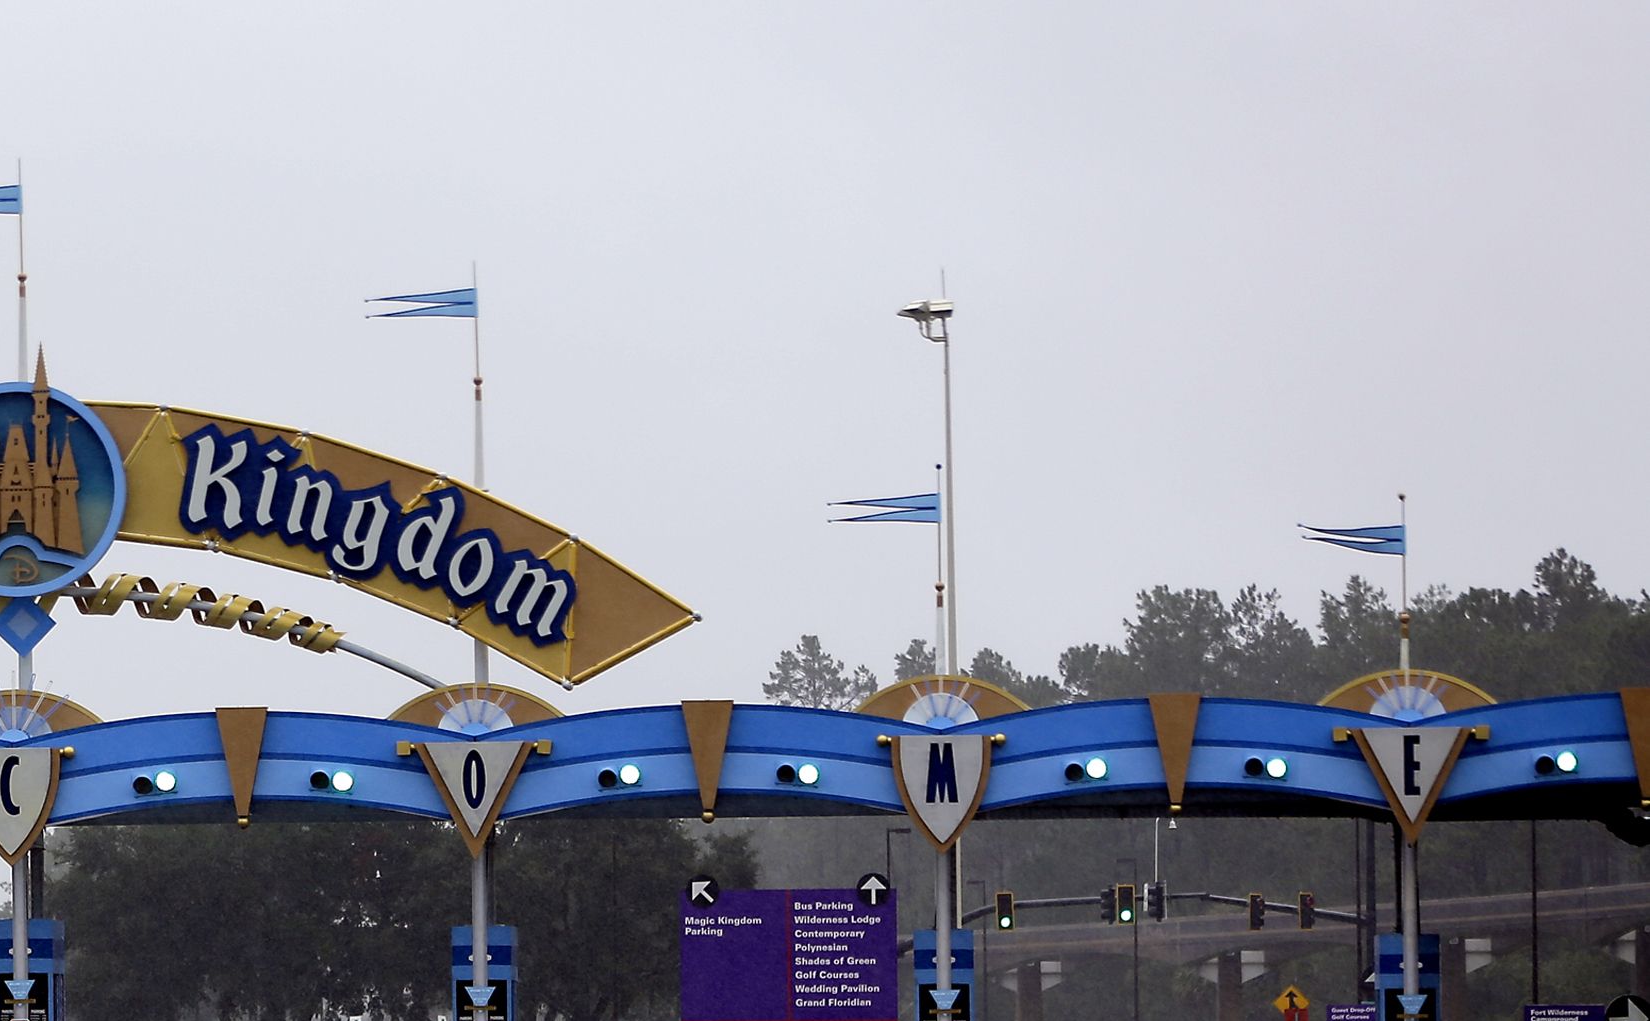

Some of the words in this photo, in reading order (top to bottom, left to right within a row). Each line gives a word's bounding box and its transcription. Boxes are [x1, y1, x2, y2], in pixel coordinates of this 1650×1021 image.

[184, 429, 572, 641] Kingdom
[1403, 735, 1422, 796] E
[925, 742, 958, 804] M
[463, 749, 485, 809] O
[0, 755, 21, 816] C
[794, 902, 813, 911] Bus
[815, 901, 854, 912] Parking
[684, 916, 715, 927] Magic
[717, 915, 762, 927] Kingdom
[794, 915, 848, 924] Wilderness
[851, 915, 881, 926] Lodge
[685, 927, 723, 937] Parking
[794, 929, 865, 940] Contemporary
[795, 943, 848, 953] Polynesian
[795, 957, 831, 966] Shades
[833, 957, 844, 965] of
[847, 956, 877, 966] Green
[795, 970, 817, 979] Golf
[819, 970, 860, 979] Courses
[795, 984, 838, 995] Wedding
[841, 984, 880, 993] Pavilion
[795, 998, 826, 1007] Grand
[828, 998, 872, 1007] Floridian
